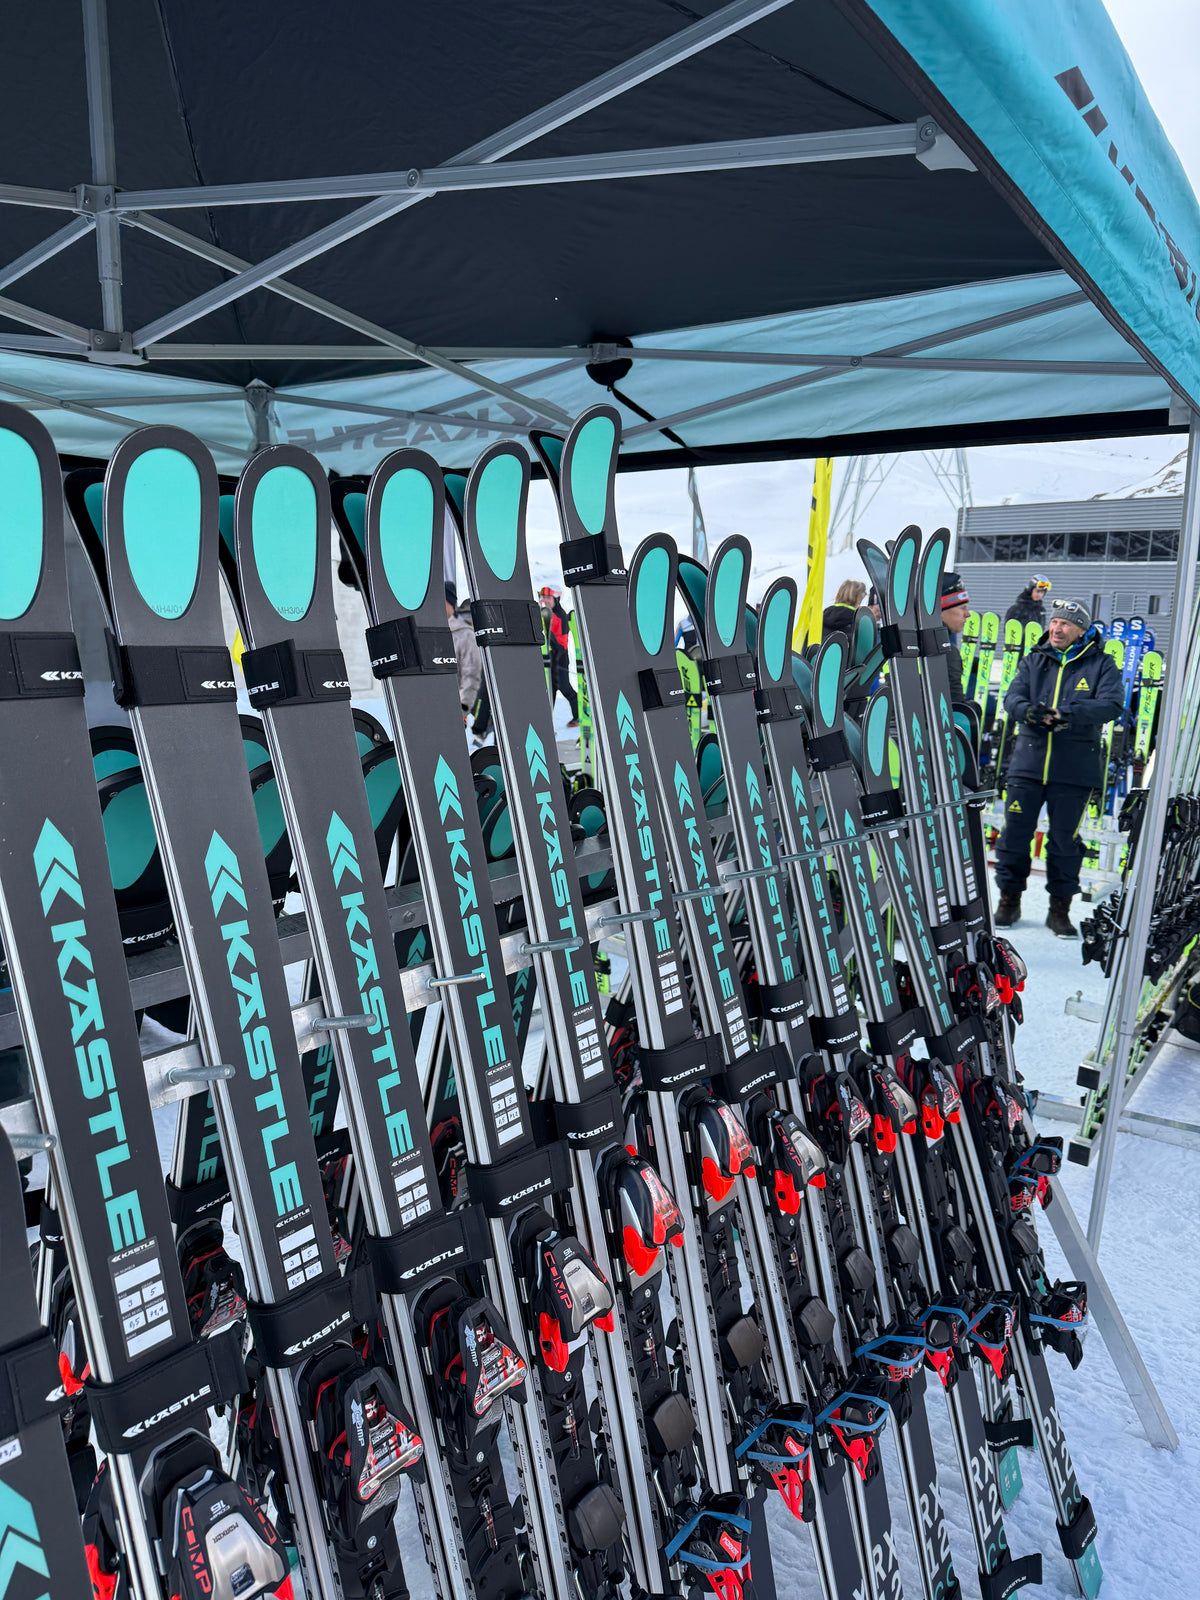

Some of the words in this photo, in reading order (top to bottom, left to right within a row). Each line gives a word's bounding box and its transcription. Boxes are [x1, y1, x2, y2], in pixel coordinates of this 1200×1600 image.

[1144, 662, 1156, 713] FISCER
[535, 791, 590, 1008] KASTLE
[446, 829, 506, 1068] KASTLE
[852, 855, 893, 1007] KASTLE
[904, 884, 952, 1028] KASTLE
[341, 891, 414, 1158] KASTLE
[51, 919, 146, 1252] KASTLE
[220, 920, 304, 1217] KASTLE
[672, 1064, 706, 1082] KASTLE
[578, 1121, 614, 1140] KASTLE
[511, 1177, 551, 1201] KASTLE
[121, 1239, 156, 1259] KASTLE
[415, 1245, 464, 1274] KASTLE
[301, 1311, 351, 1349] KASTLE
[143, 1384, 211, 1430] KASTLE
[1043, 1406, 1065, 1445] RX
[971, 1445, 995, 1491] RX
[1053, 1446, 1076, 1493] 12
[920, 1481, 945, 1529] RX
[979, 1483, 1002, 1539] 12
[926, 1518, 951, 1578] 12
